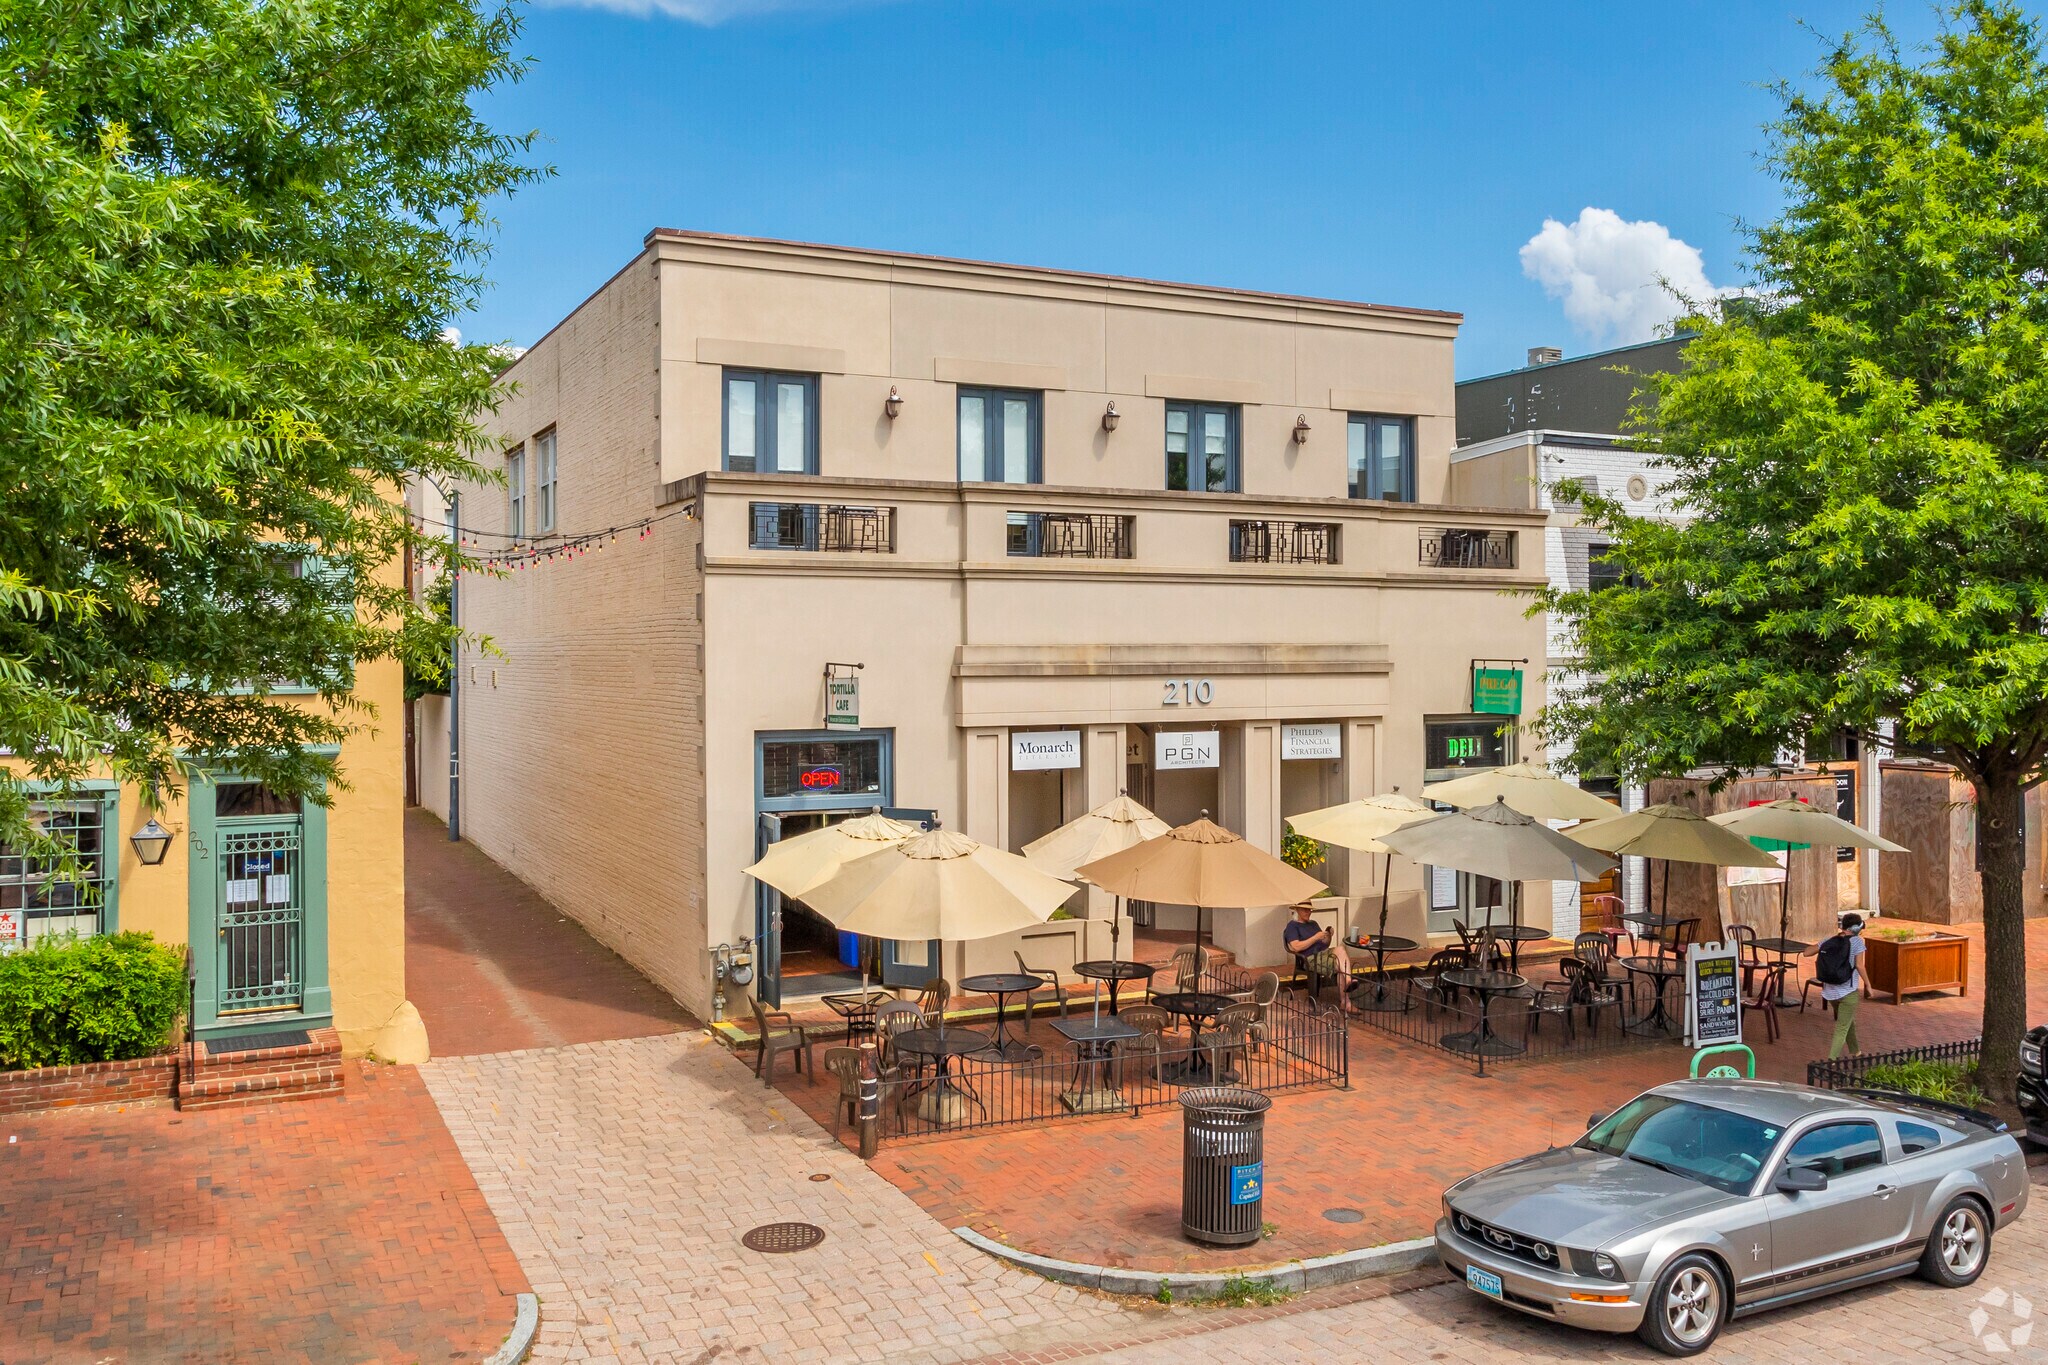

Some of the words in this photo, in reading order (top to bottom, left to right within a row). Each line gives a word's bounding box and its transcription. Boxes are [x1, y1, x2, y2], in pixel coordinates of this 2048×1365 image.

[829, 683, 856, 695] TORTILLA
[1163, 678, 1214, 705] 210
[836, 699, 849, 711] CAFE
[1019, 741, 1073, 754] Monarch
[1165, 747, 1210, 761] PGN
[1448, 737, 1482, 758] DELI
[801, 771, 840, 787] OPEN
[189, 831, 208, 859] 202
[1700, 976, 1733, 990] BREAKFAST
